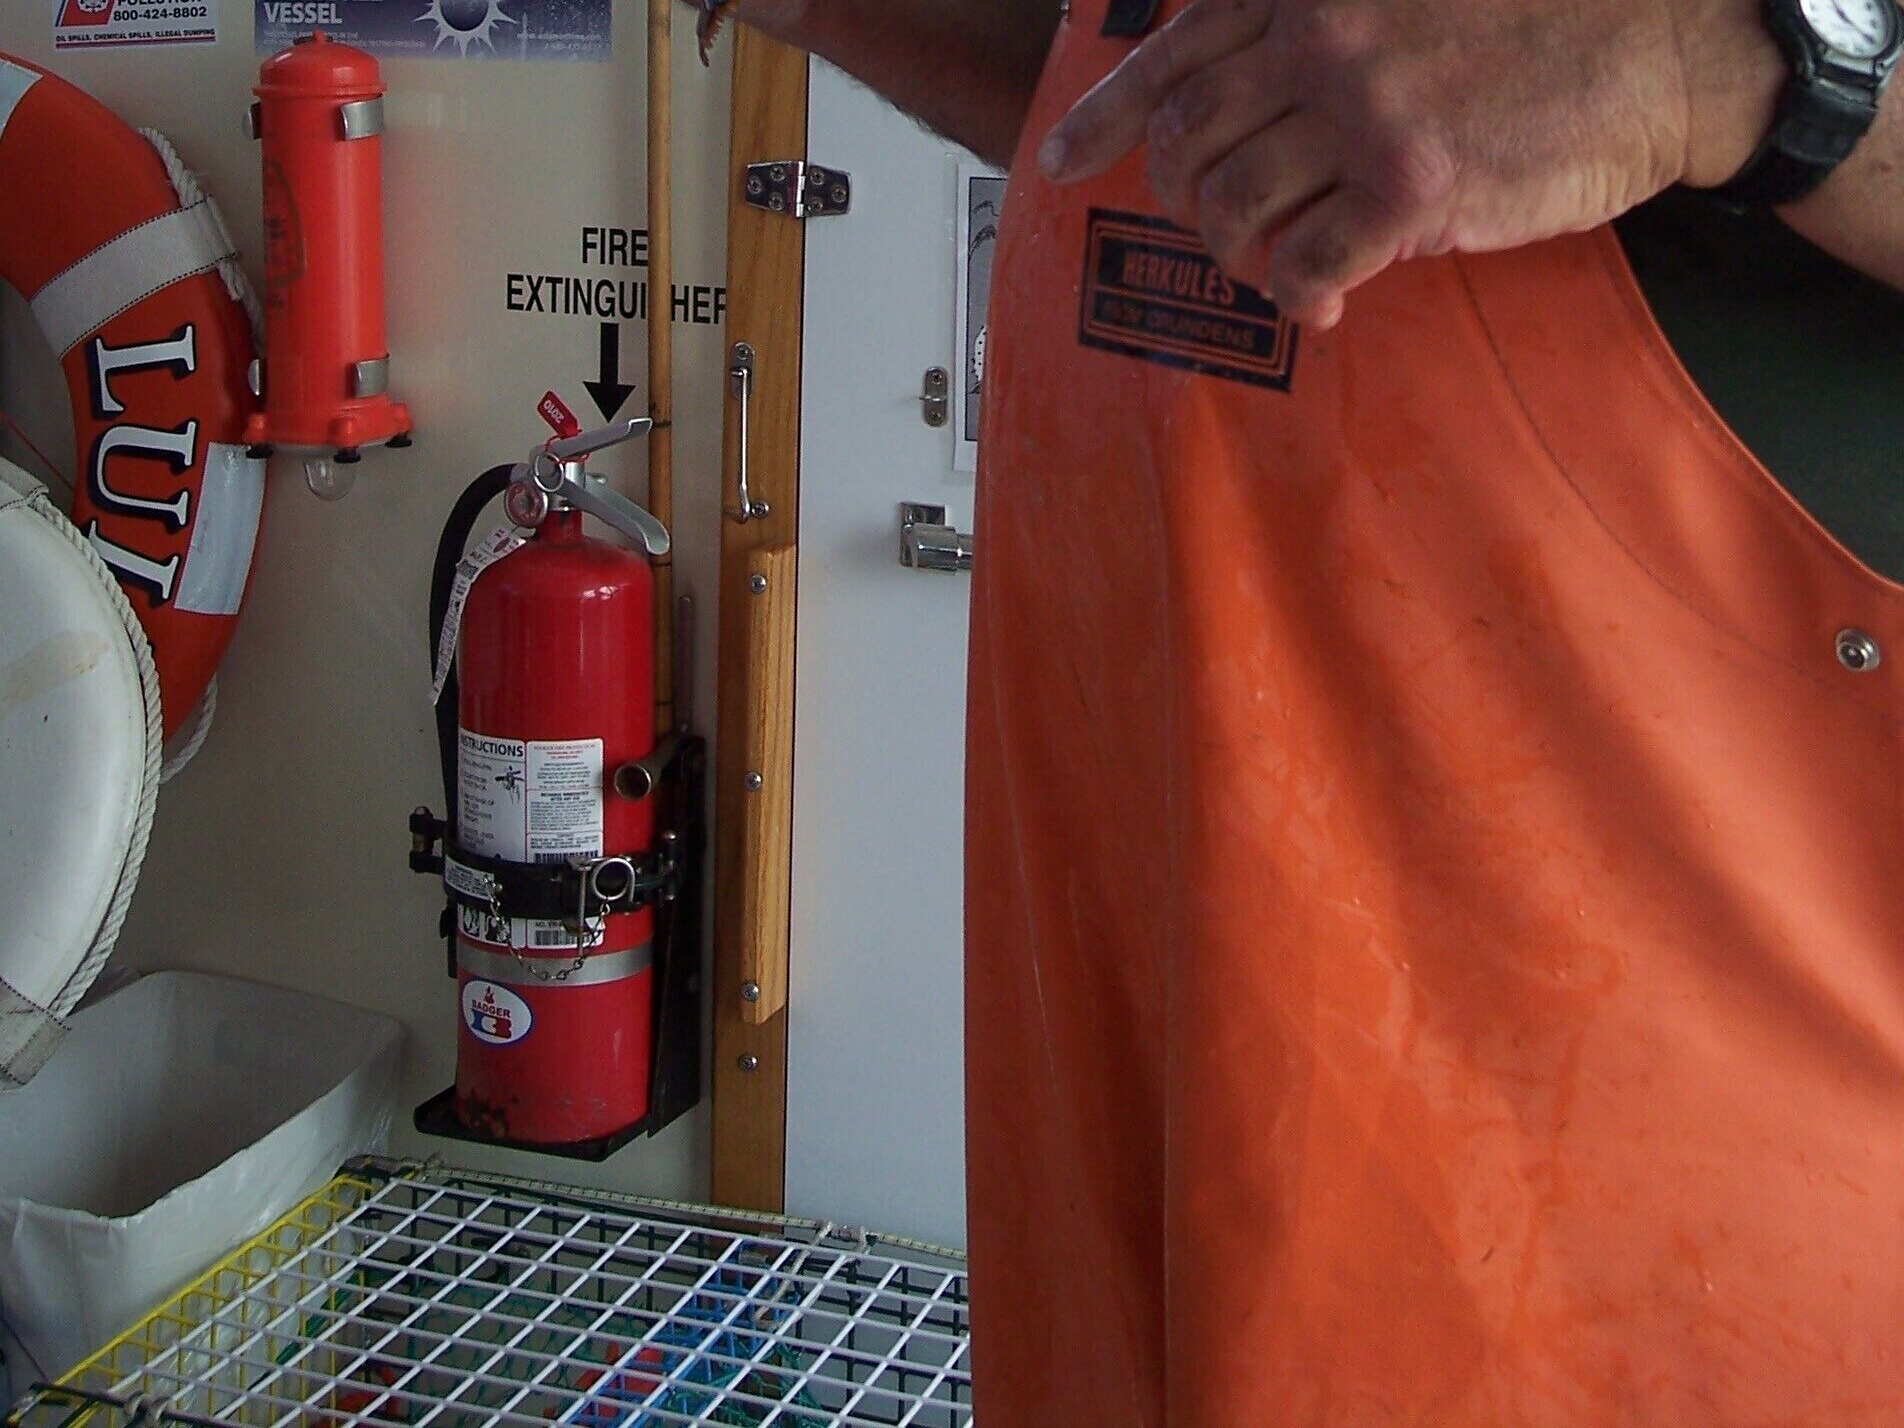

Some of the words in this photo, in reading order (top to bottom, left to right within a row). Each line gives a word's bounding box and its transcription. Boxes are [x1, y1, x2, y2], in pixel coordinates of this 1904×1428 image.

[113, 6, 207, 21] 800-424-8802
[264, 2, 343, 24] VESSEL
[93, 31, 127, 41] CHEMICAL
[154, 29, 182, 38] ILLEGAL
[182, 28, 216, 37] DUMPING
[582, 227, 649, 267] FIRE
[506, 273, 727, 325] EXTINGUIHER
[471, 998, 512, 1019] BADGER
